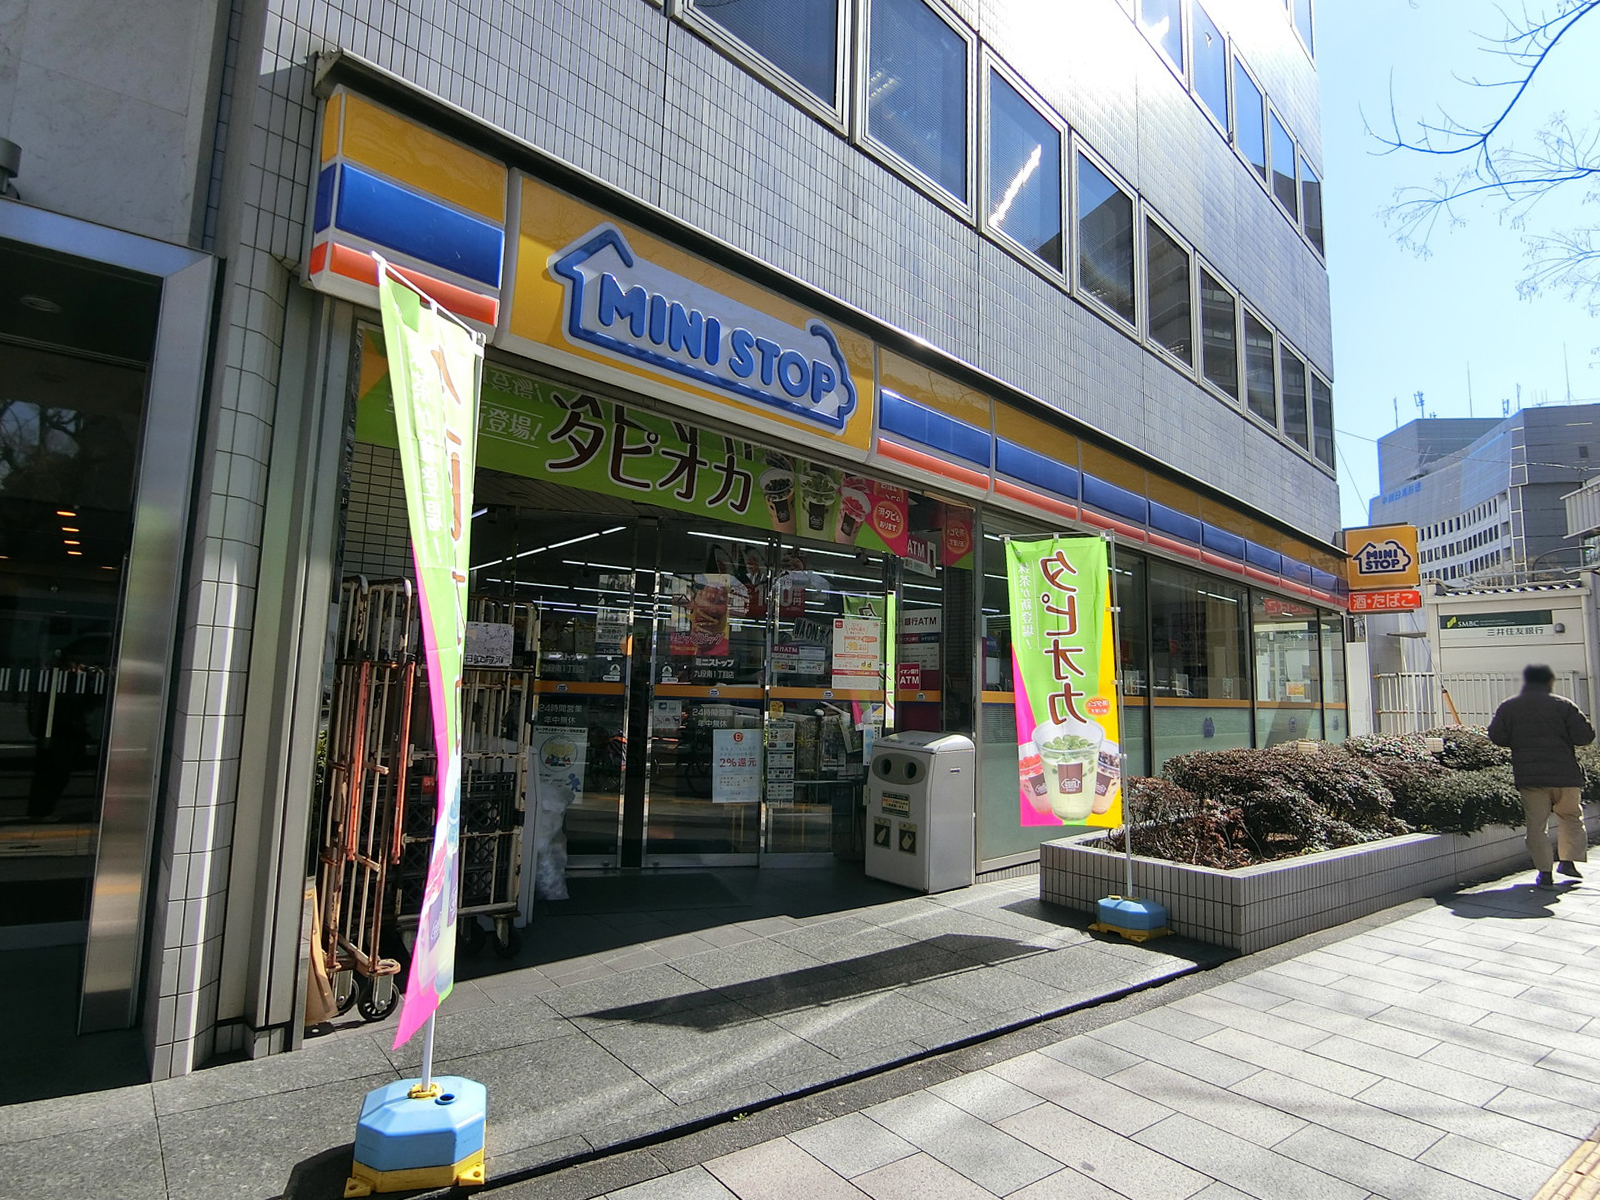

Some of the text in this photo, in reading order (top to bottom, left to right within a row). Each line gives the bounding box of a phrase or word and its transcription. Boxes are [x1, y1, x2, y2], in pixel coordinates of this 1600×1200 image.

[597, 271, 837, 405] MINI STOP
[547, 408, 752, 514] タピオカ
[907, 539, 925, 558] ATM
[1365, 548, 1398, 560] MINI
[1364, 559, 1400, 571] STOP
[1352, 592, 1415, 611] 酒・たばこ
[1457, 619, 1480, 628] SMBC
[1486, 626, 1544, 637] 三井住友銀行
[695, 657, 734, 667] ミニストップ
[899, 675, 920, 686] ATM
[538, 703, 583, 713] 24時間営業
[691, 708, 734, 717] 24時間営業
[543, 715, 577, 725] 年中無休
[697, 719, 728, 728] 年中無休
[719, 757, 757, 768] 2%還元
